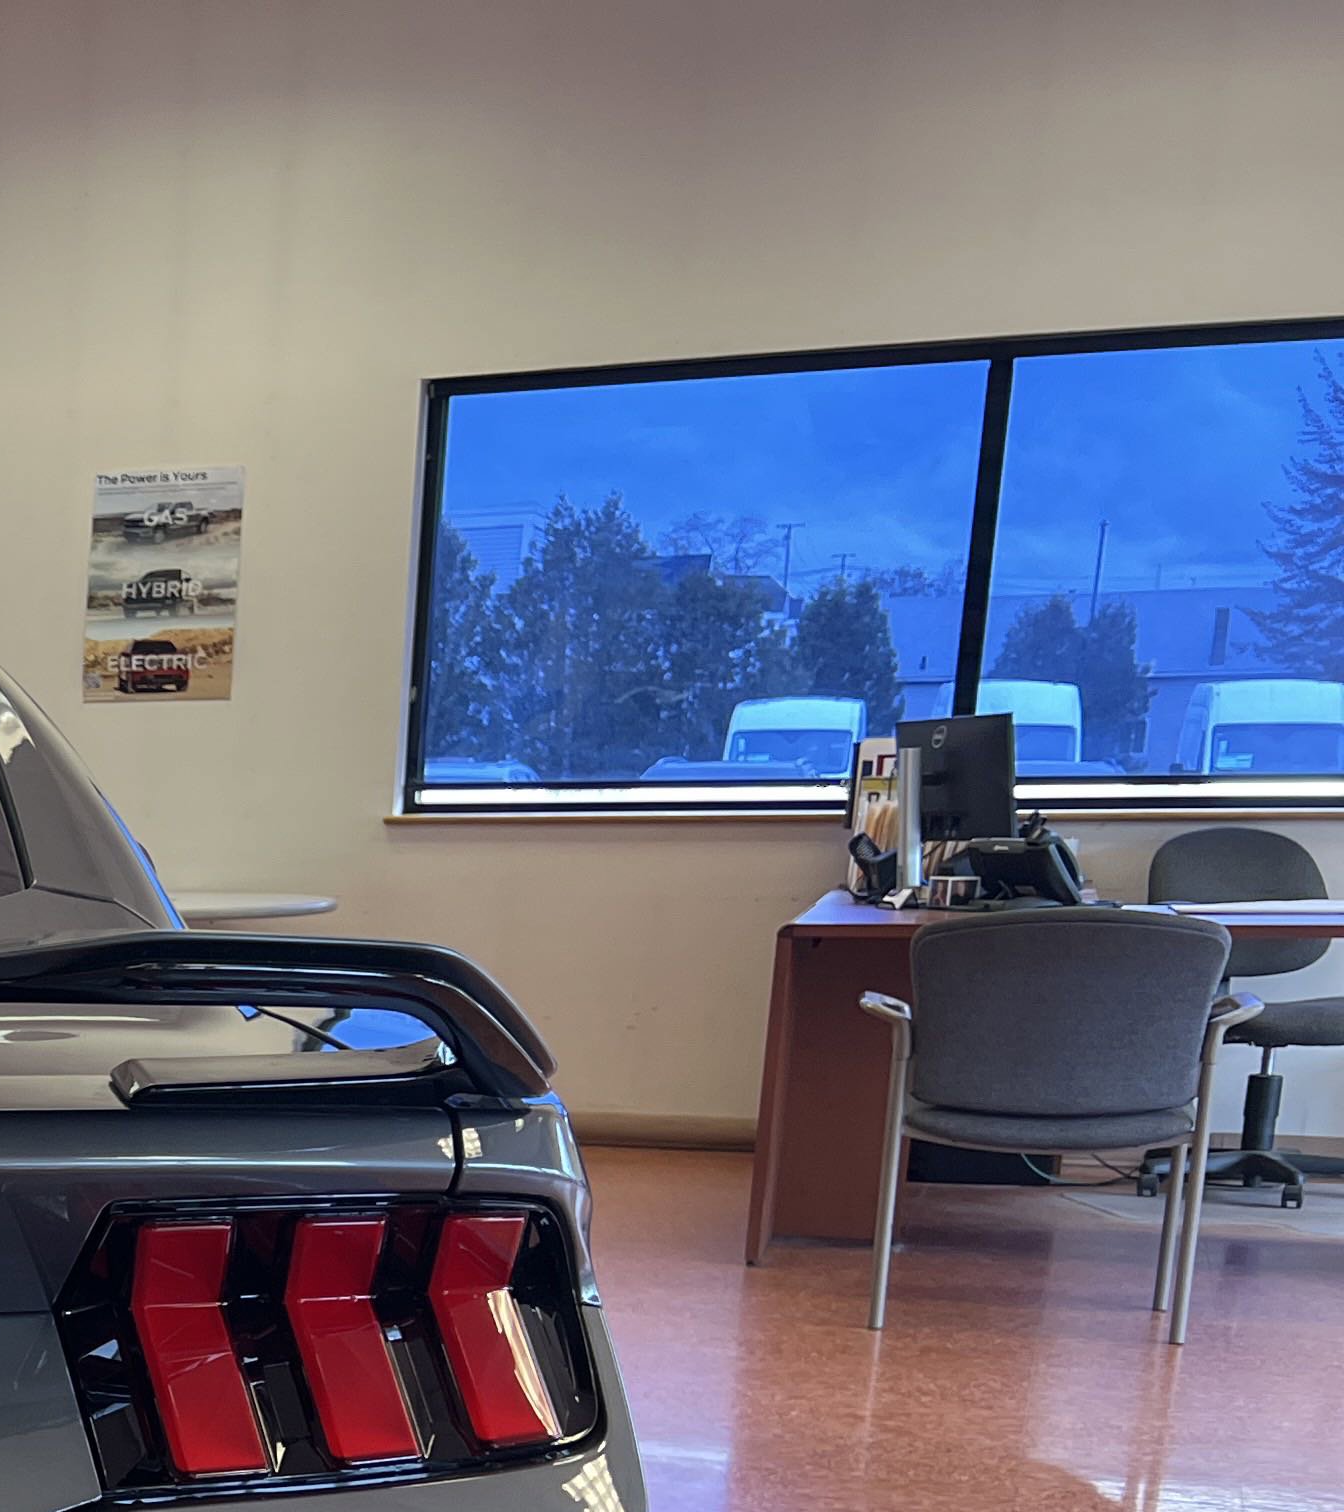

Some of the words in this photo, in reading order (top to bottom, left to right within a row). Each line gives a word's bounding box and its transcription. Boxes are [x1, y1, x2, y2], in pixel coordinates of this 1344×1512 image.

[96, 474, 118, 486] The
[120, 473, 157, 485] Power
[173, 471, 208, 482] Yours
[143, 508, 188, 527] GAS
[121, 580, 203, 600] HYBRID
[106, 652, 208, 673] ELECTRIC
